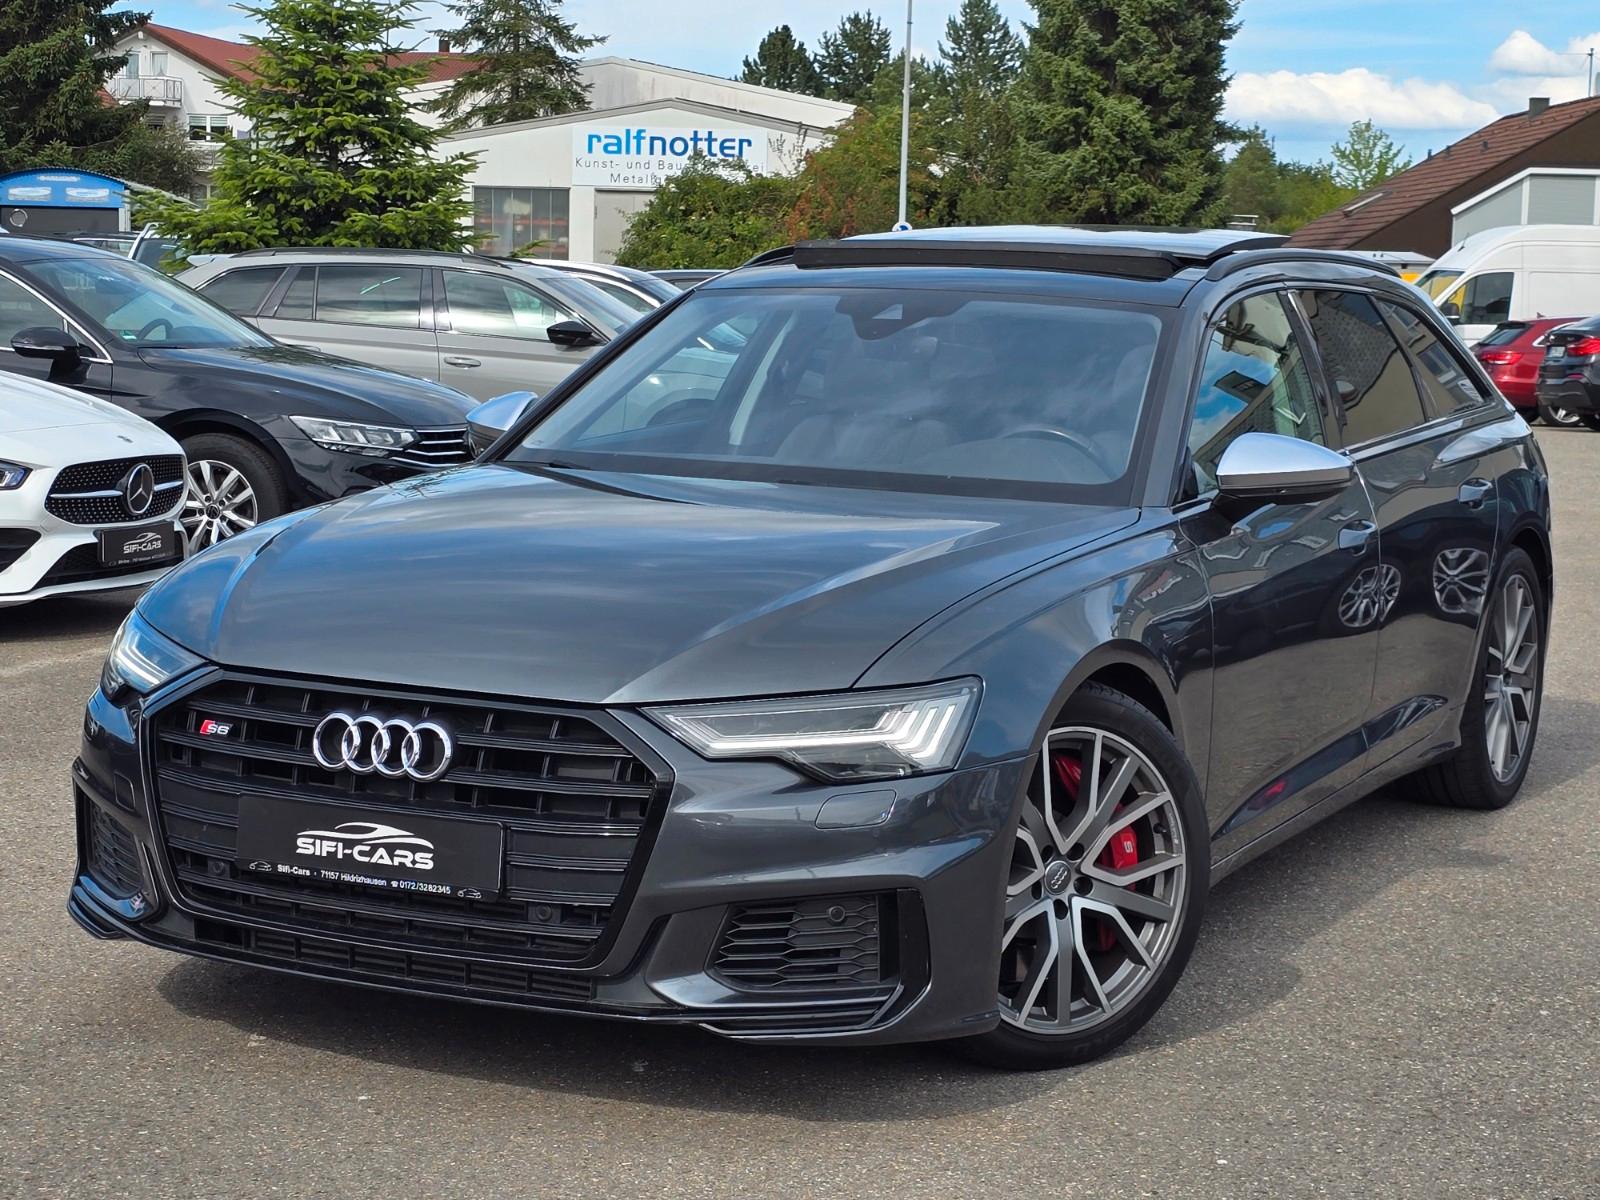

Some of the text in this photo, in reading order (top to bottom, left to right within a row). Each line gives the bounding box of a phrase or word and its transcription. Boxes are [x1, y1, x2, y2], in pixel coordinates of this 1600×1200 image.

[575, 157, 620, 169] Kunst-
[626, 158, 650, 169] und
[123, 540, 162, 554] SIFI-CARS
[206, 722, 230, 735] S6
[296, 837, 434, 870] SIFI-CARS
[320, 869, 340, 881] 71157
